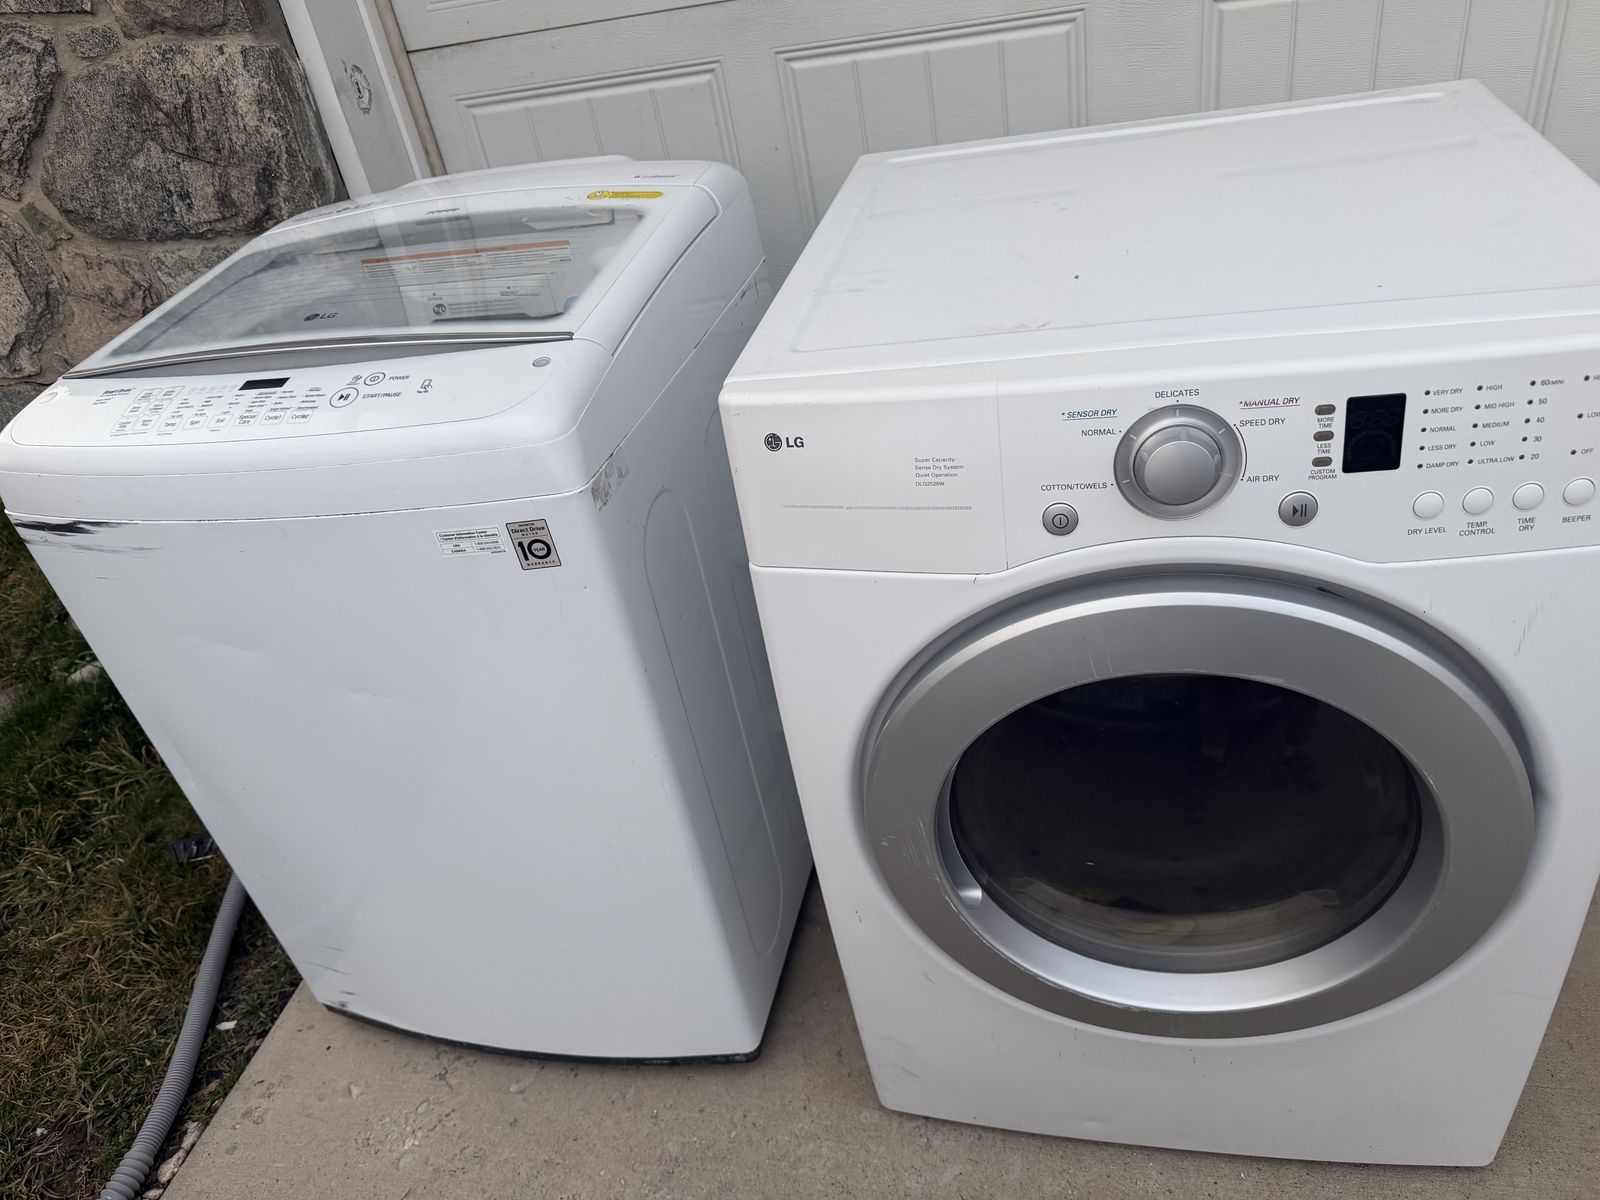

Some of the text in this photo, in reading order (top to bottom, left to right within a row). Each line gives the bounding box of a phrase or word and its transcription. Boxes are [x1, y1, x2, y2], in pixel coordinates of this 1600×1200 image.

[1155, 388, 1200, 399] DELICATES
[1282, 397, 1300, 406] DRY
[1101, 408, 1117, 416] DRY
[1240, 417, 1286, 427] SPEED DRY
[1081, 428, 1116, 437] NORMAL
[786, 436, 804, 448] LG
[1041, 482, 1107, 491] COTTON/TOWELS
[1562, 514, 1591, 524] BEEPER
[1408, 526, 1447, 536] DRY LEVEL
[1459, 528, 1495, 537] CONTROL
[517, 539, 552, 561] 10
